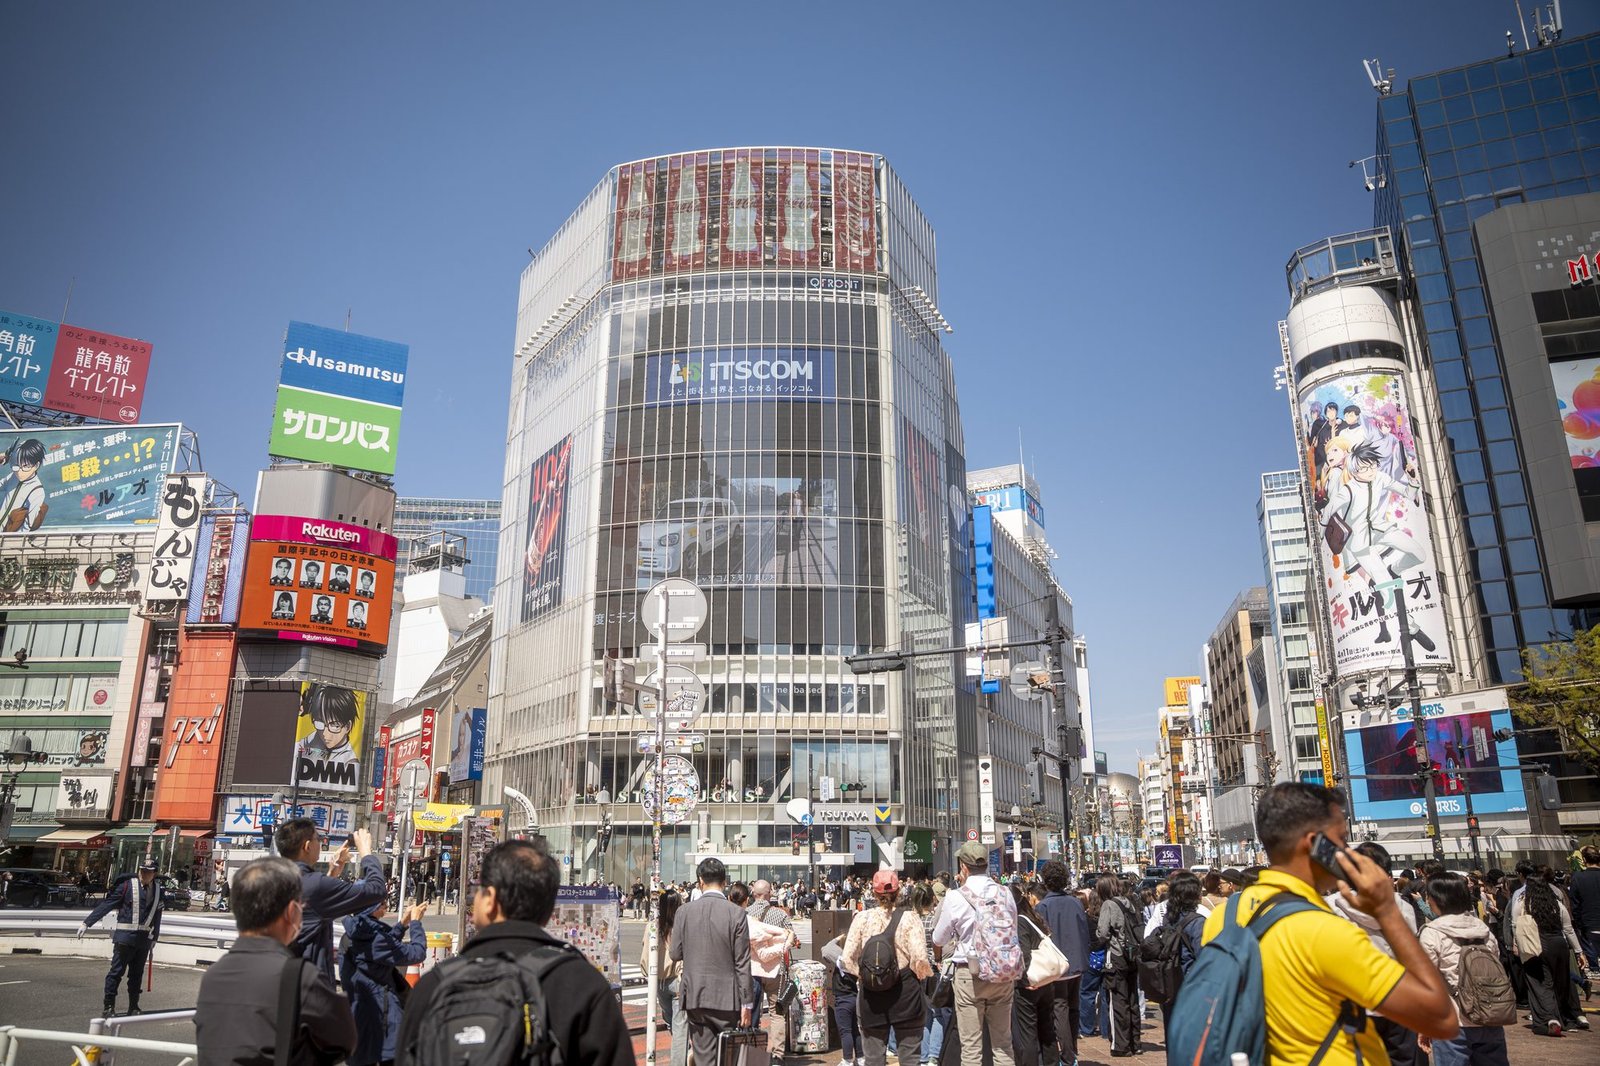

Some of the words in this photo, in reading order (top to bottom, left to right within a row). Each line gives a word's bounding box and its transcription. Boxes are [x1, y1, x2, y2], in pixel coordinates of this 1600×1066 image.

[809, 277, 859, 290] QFRONT
[75, 346, 132, 376] 龍角散
[286, 347, 404, 384] Hisamitsu
[64, 367, 137, 398] ダイレクト
[283, 408, 390, 453] サロンパス
[81, 478, 149, 511] キルアオ
[151, 475, 200, 597] もんじゃ
[302, 522, 361, 543] Rakuten
[278, 545, 375, 566] 国際手配中の日本赤軍
[1332, 571, 1431, 629] キルアオ
[302, 633, 322, 641] Rakuten
[793, 685, 823, 695] based
[841, 686, 867, 695] CAFE
[165, 703, 225, 769] クスリ
[397, 739, 419, 759] カラオケ
[420, 715, 433, 762] カラオケ
[300, 757, 356, 786] DMM
[1323, 749, 1332, 773] TOUCH
[820, 810, 869, 820] TSUTAYA
